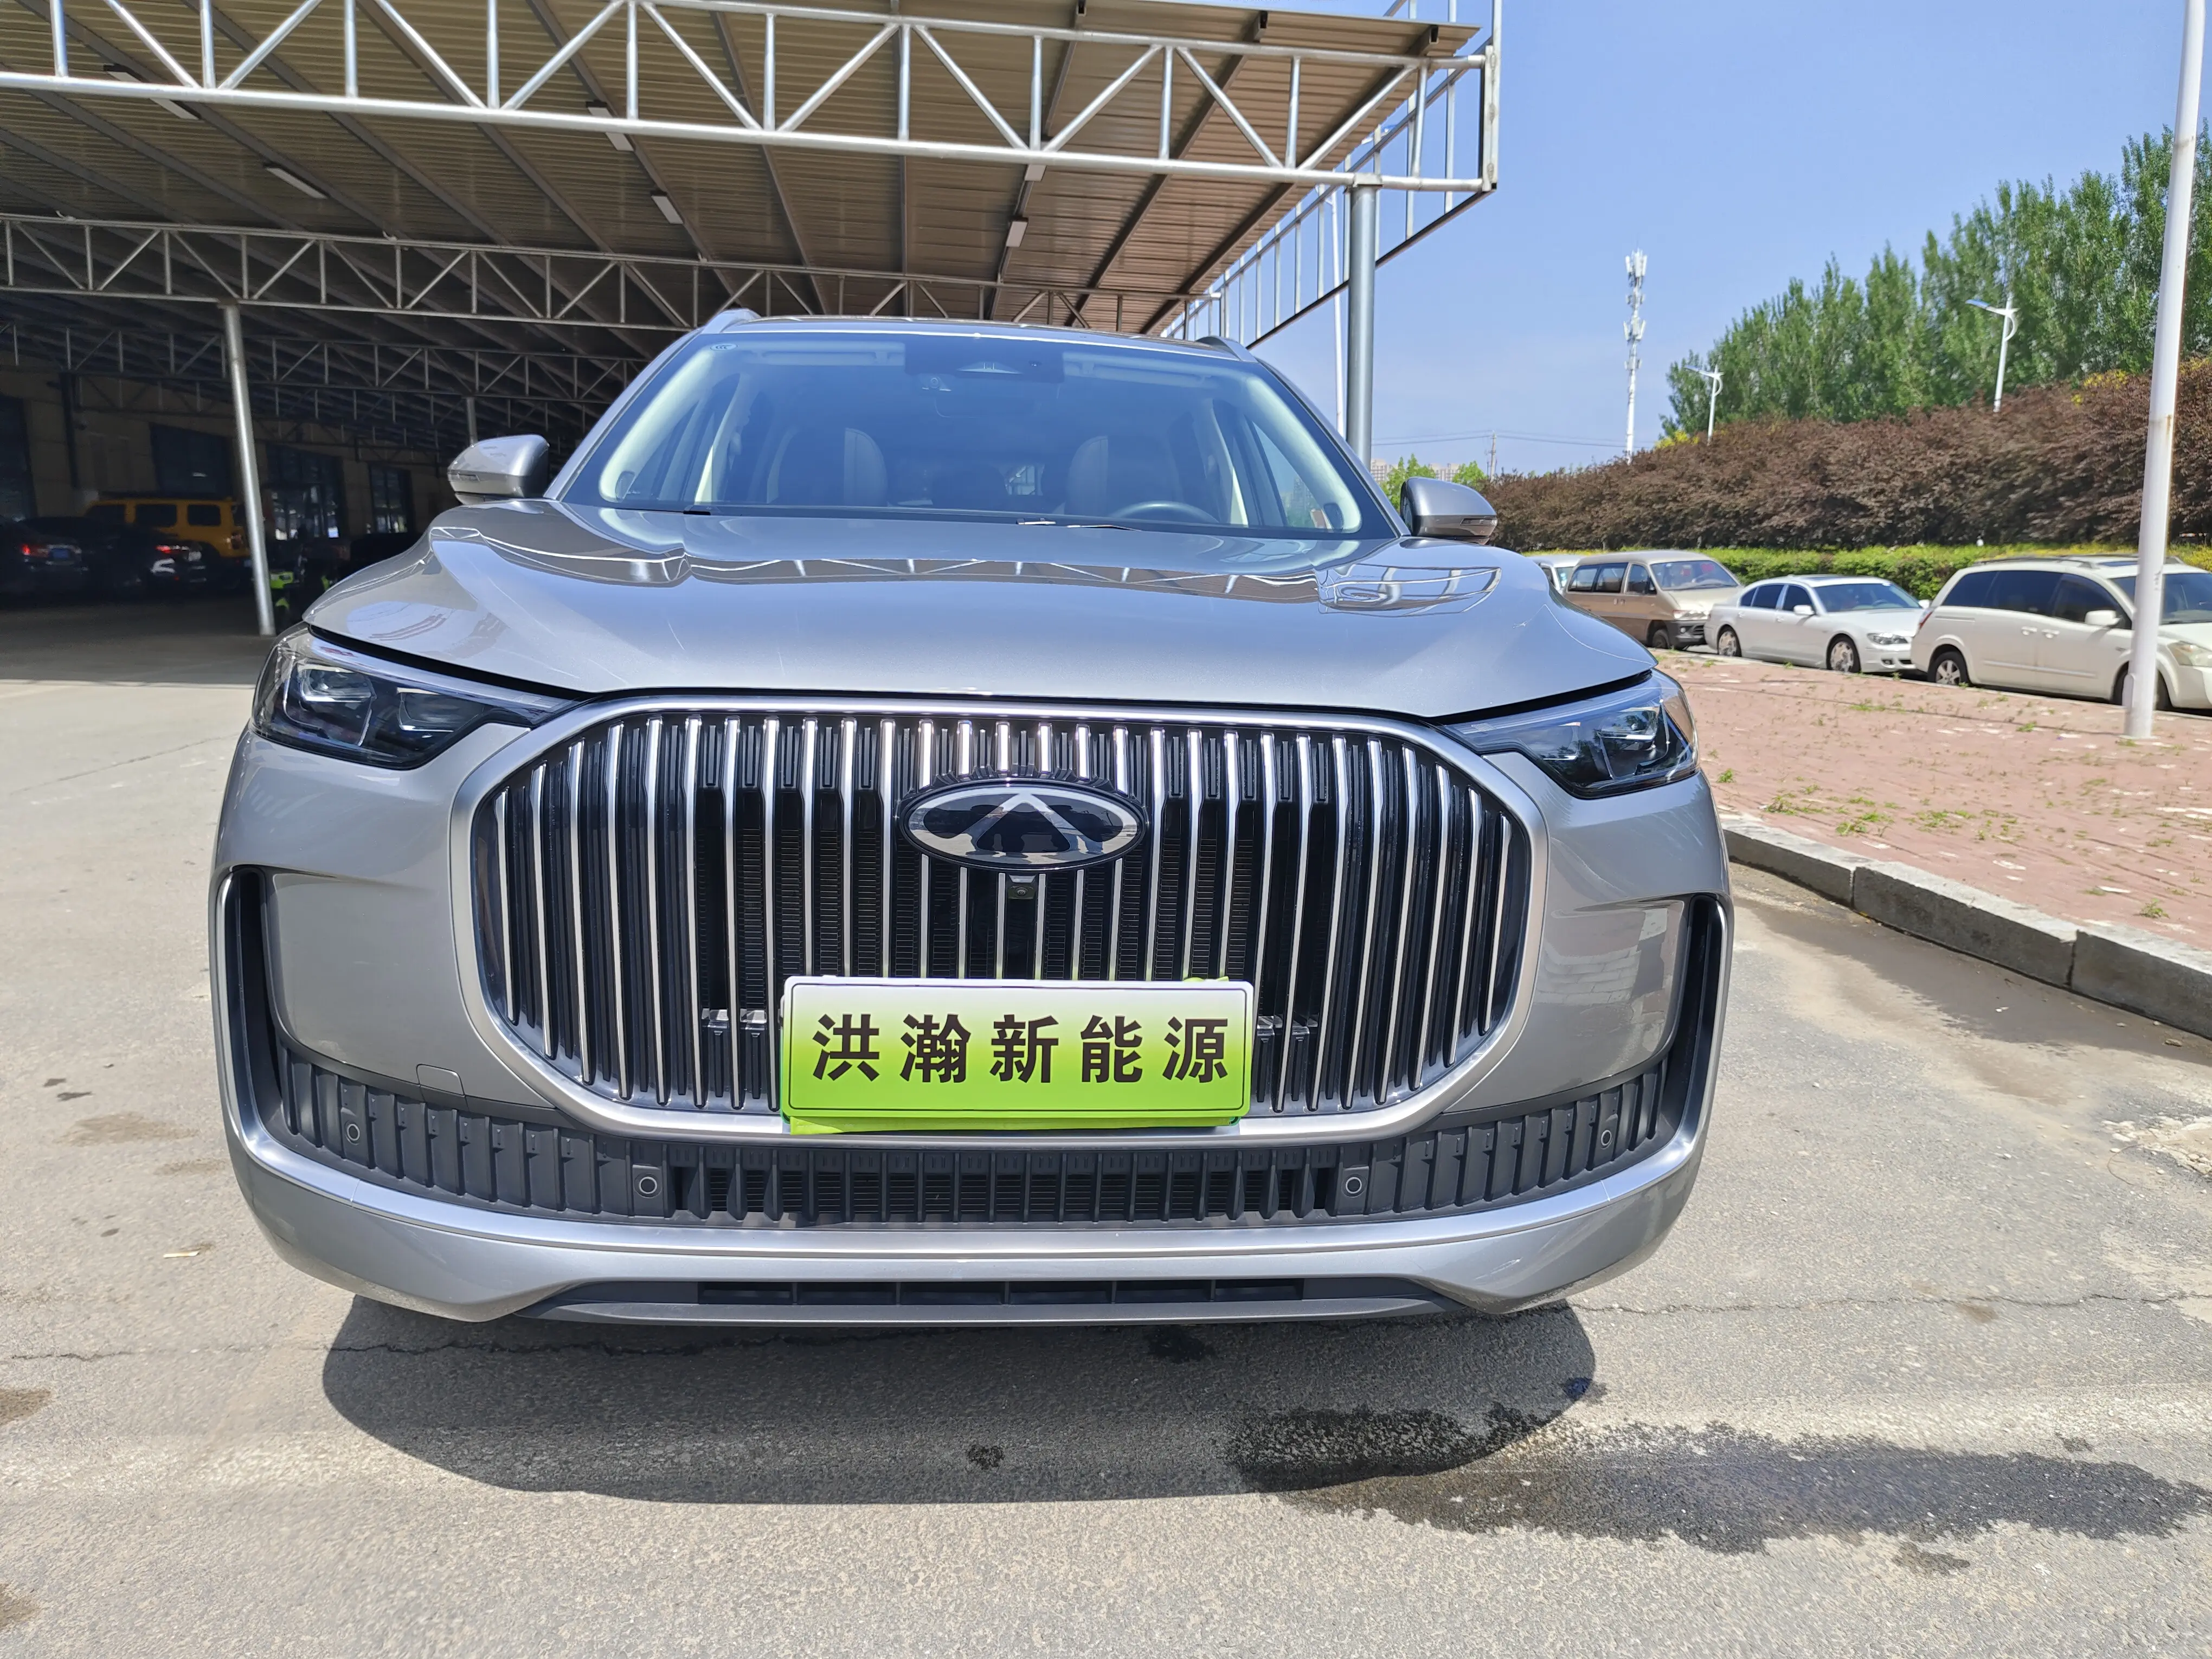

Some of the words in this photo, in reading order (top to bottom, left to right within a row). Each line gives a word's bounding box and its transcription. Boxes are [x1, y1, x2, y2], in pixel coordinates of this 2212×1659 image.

[813, 1013, 1229, 1083] 洪瀚新能源
